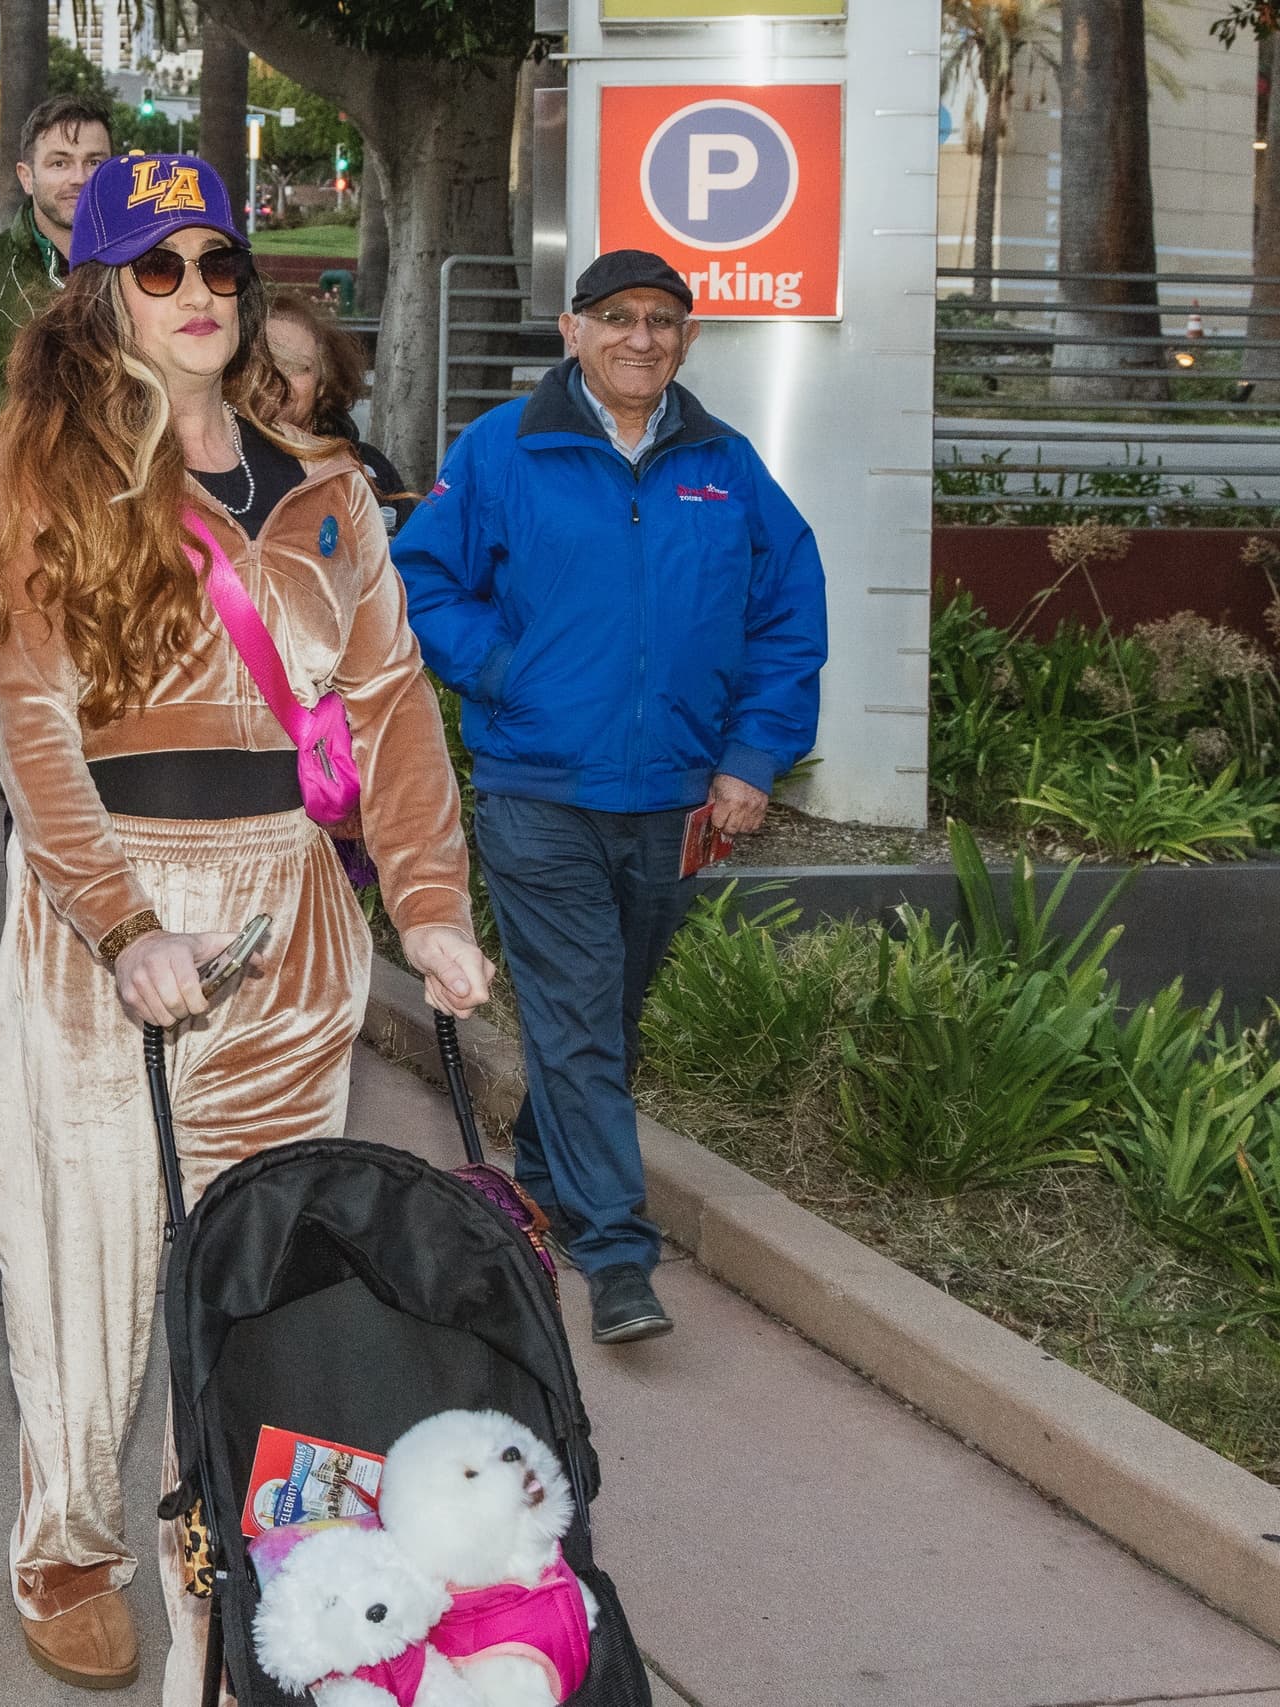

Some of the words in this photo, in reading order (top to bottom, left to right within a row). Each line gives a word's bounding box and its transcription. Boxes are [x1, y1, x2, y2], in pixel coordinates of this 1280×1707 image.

[127, 160, 206, 214] LA
[688, 133, 759, 221] P
[679, 261, 803, 309] rking
[303, 1448, 315, 1467] TOUR
[279, 1481, 298, 1527] CELEBRITY
[292, 1444, 307, 1478] HOMES
